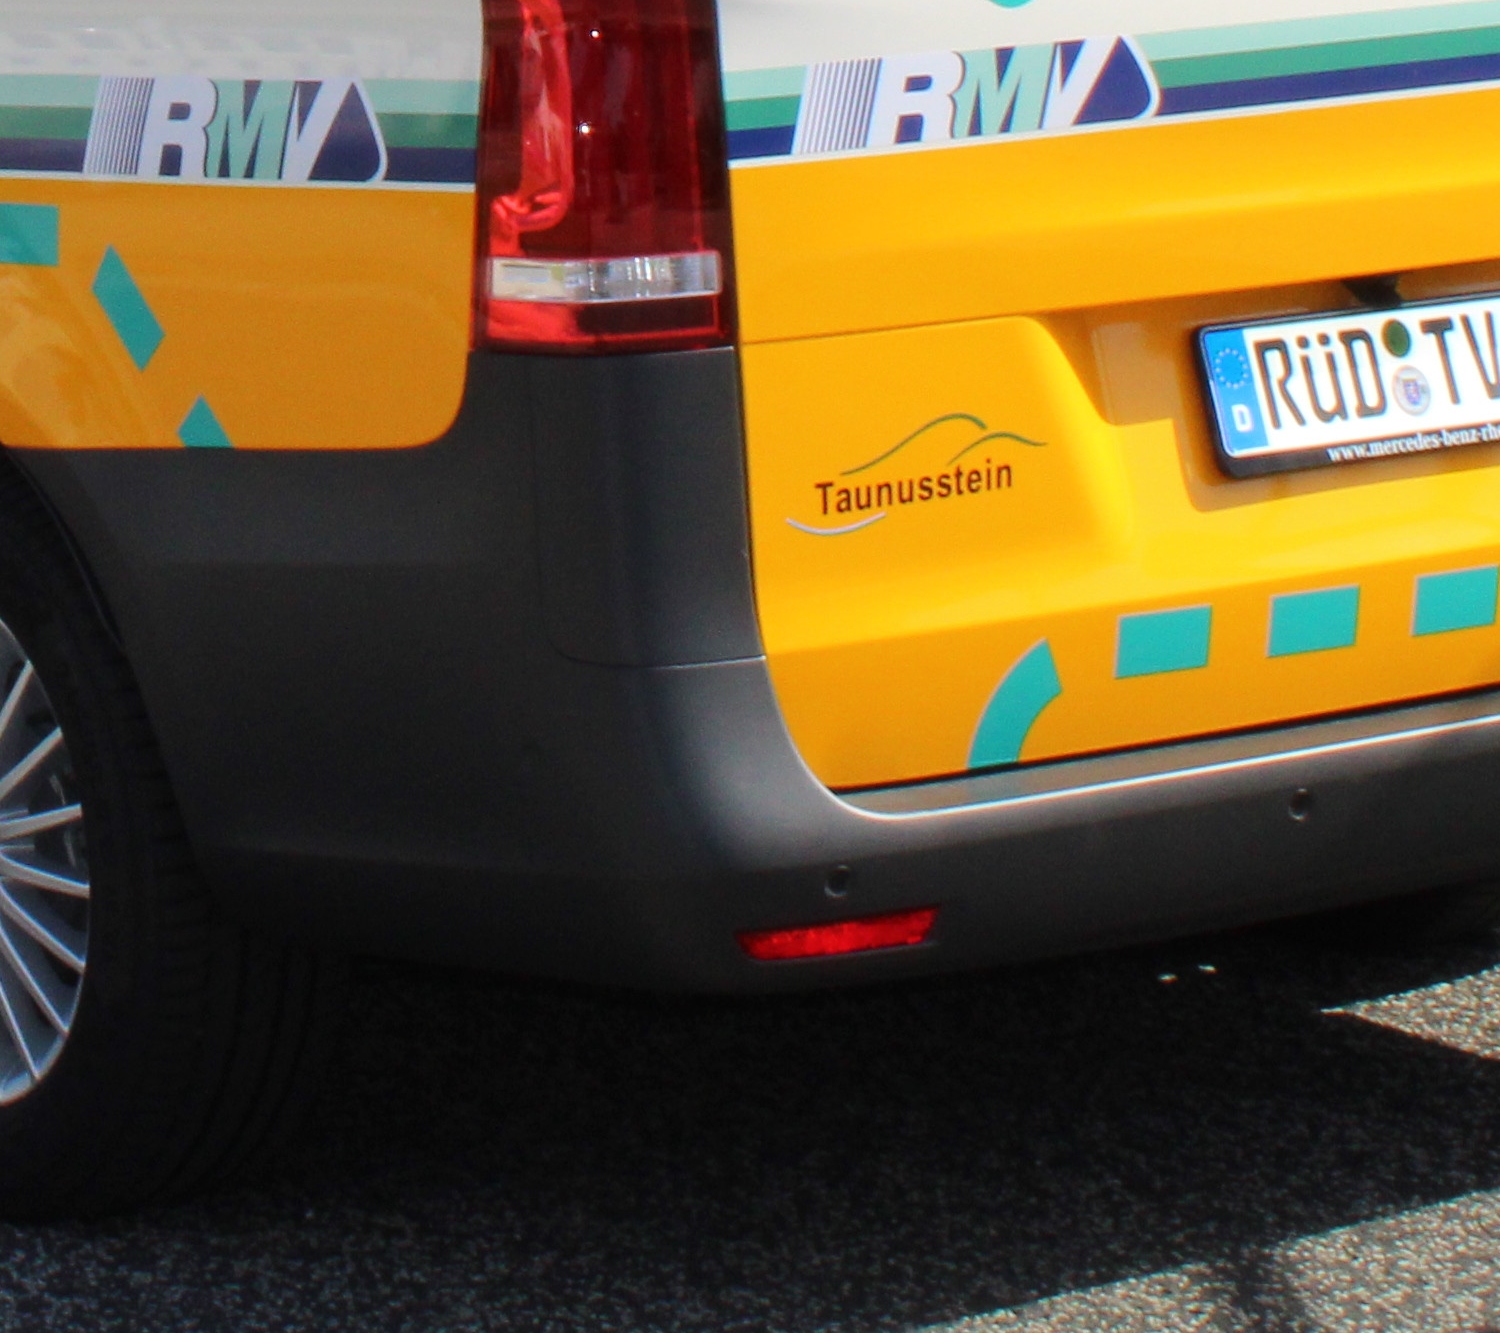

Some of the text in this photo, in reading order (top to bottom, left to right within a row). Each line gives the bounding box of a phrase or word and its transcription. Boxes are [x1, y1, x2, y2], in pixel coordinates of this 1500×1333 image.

[138, 77, 357, 181] RMV
[866, 36, 1121, 146] RMV
[1231, 403, 1254, 433] D
[1254, 328, 1388, 431] RÜD
[815, 457, 1013, 516] Taunusstein
